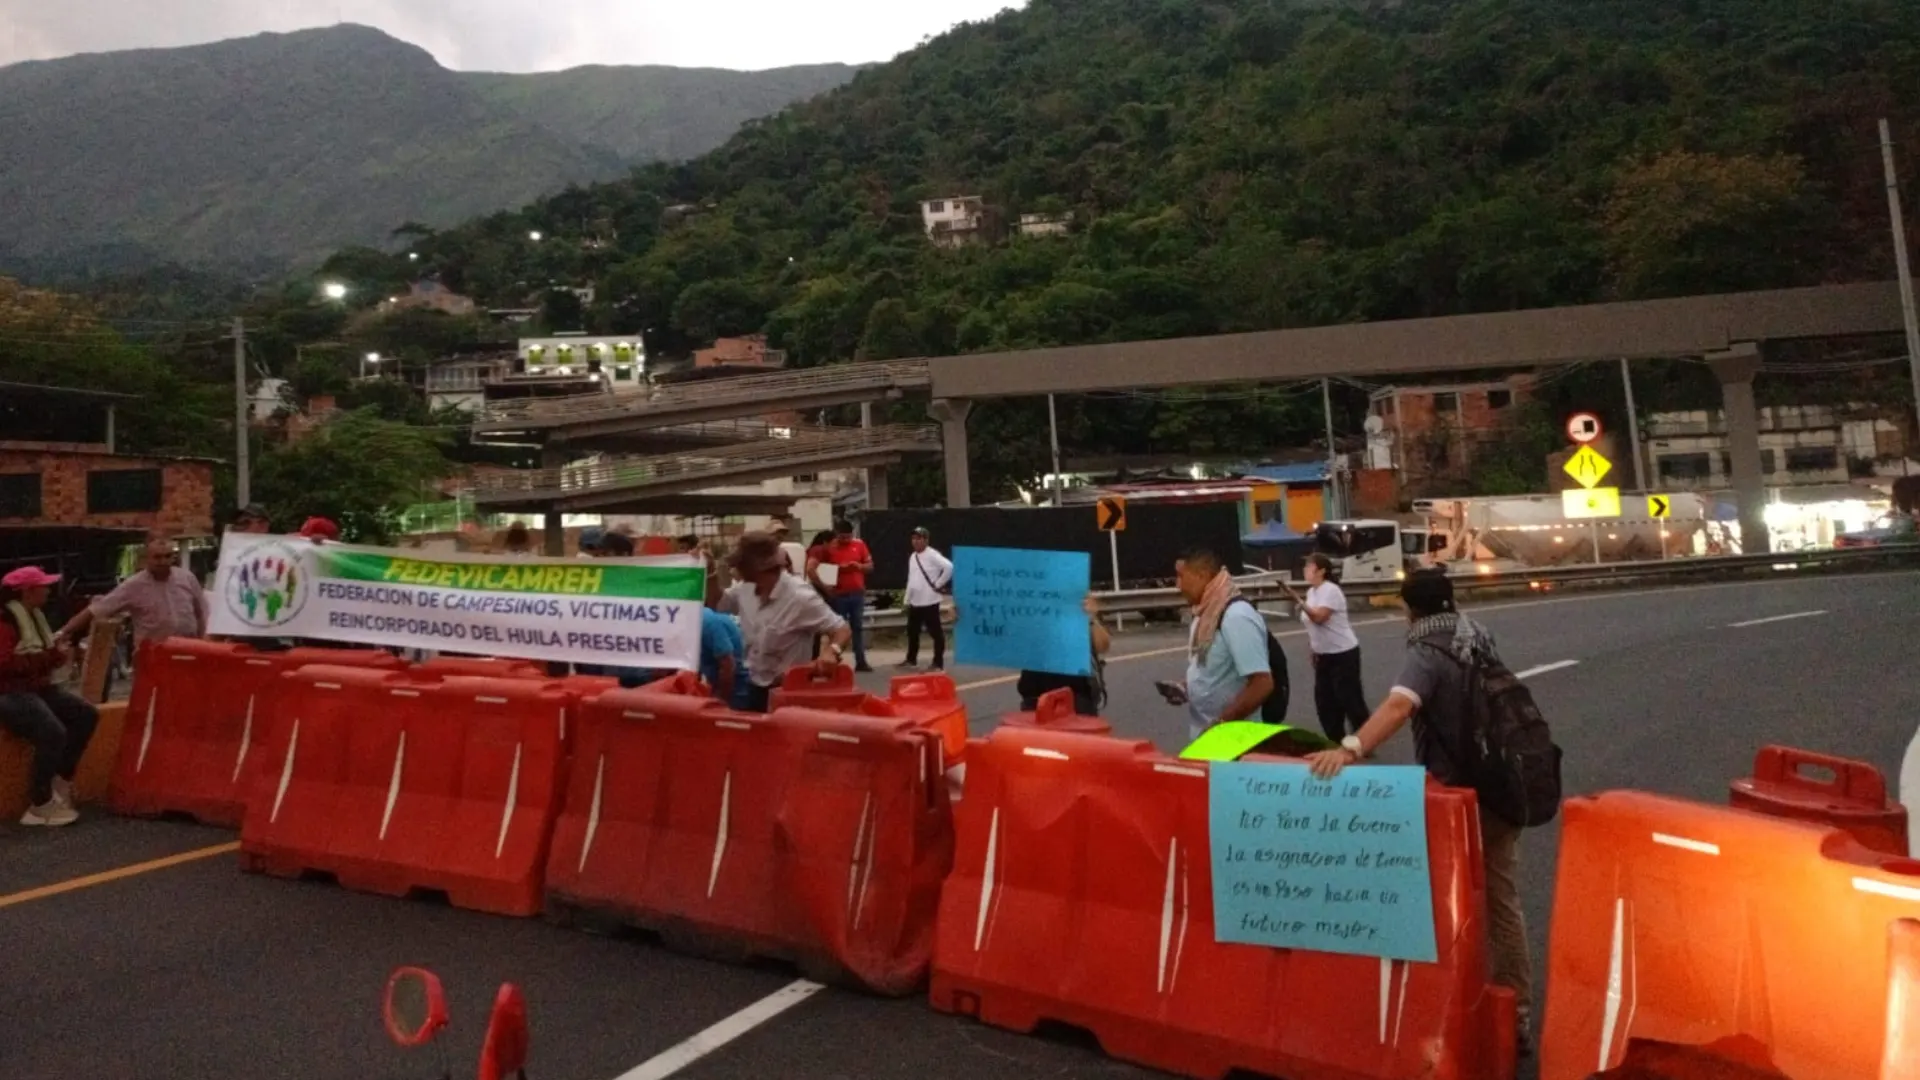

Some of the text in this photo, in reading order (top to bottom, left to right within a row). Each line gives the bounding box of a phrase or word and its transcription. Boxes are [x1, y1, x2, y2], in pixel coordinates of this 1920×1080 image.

[383, 558, 604, 594] FEDEVICAMREH
[318, 582, 681, 624] FEDERACION DE CAMPESINOS, VICTIMAS Y
[328, 611, 666, 655] REINCORPORADO DEL HUILA PRESENTE
